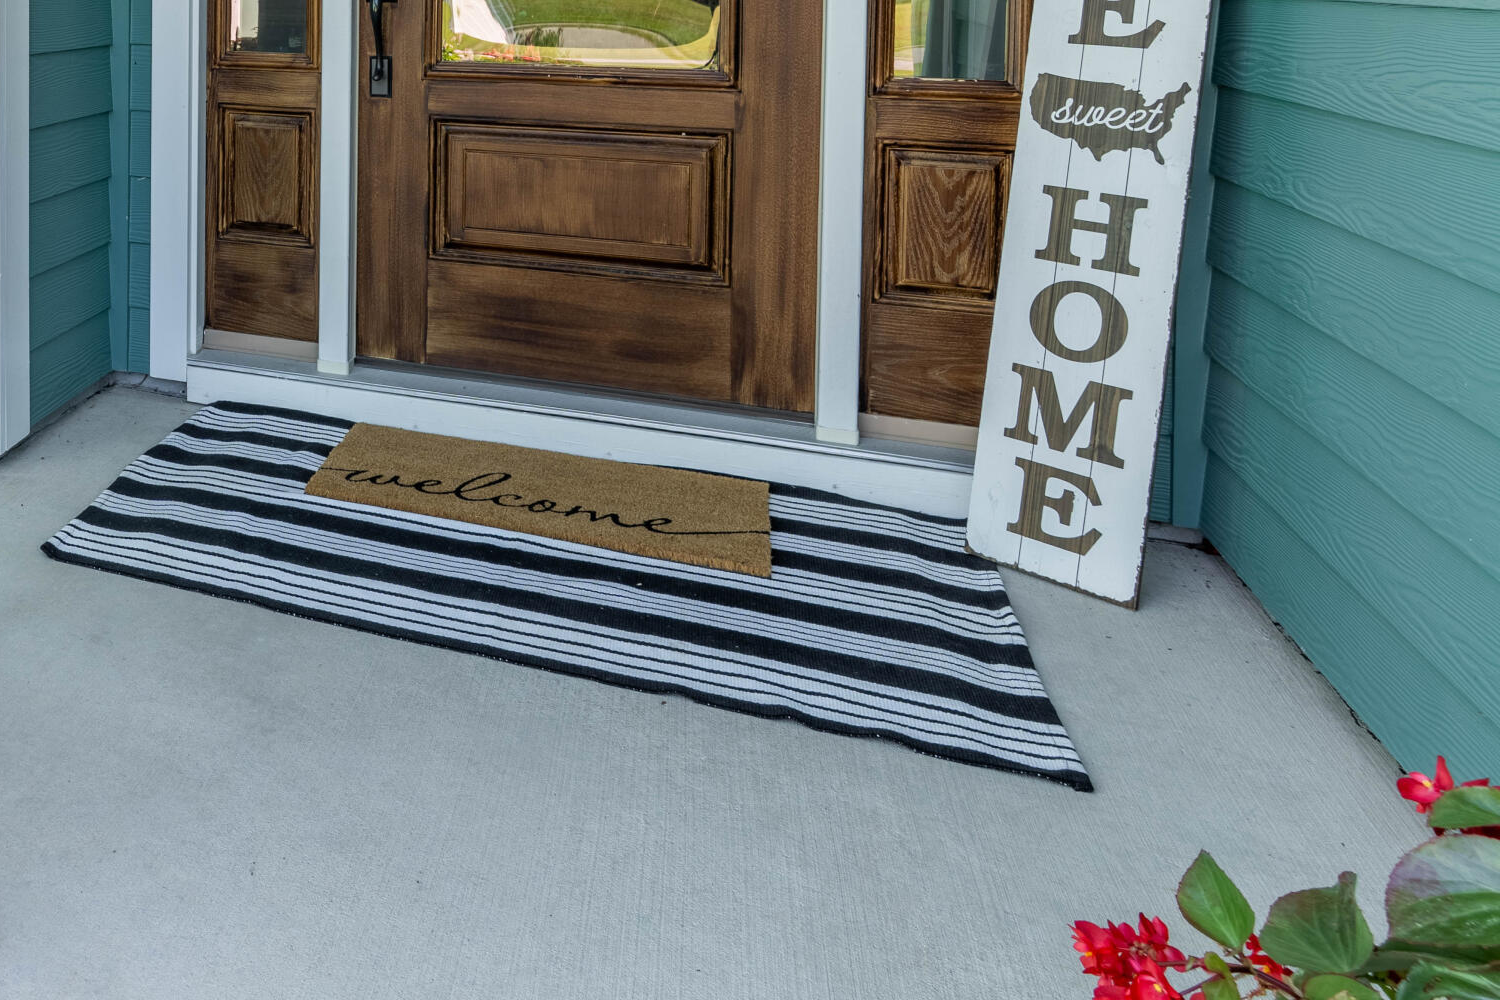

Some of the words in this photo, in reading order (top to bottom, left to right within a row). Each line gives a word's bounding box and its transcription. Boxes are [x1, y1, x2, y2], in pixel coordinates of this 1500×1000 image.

[1050, 96, 1165, 134] sweet
[1003, 184, 1148, 556] HOME
[321, 467, 770, 535] welcome
